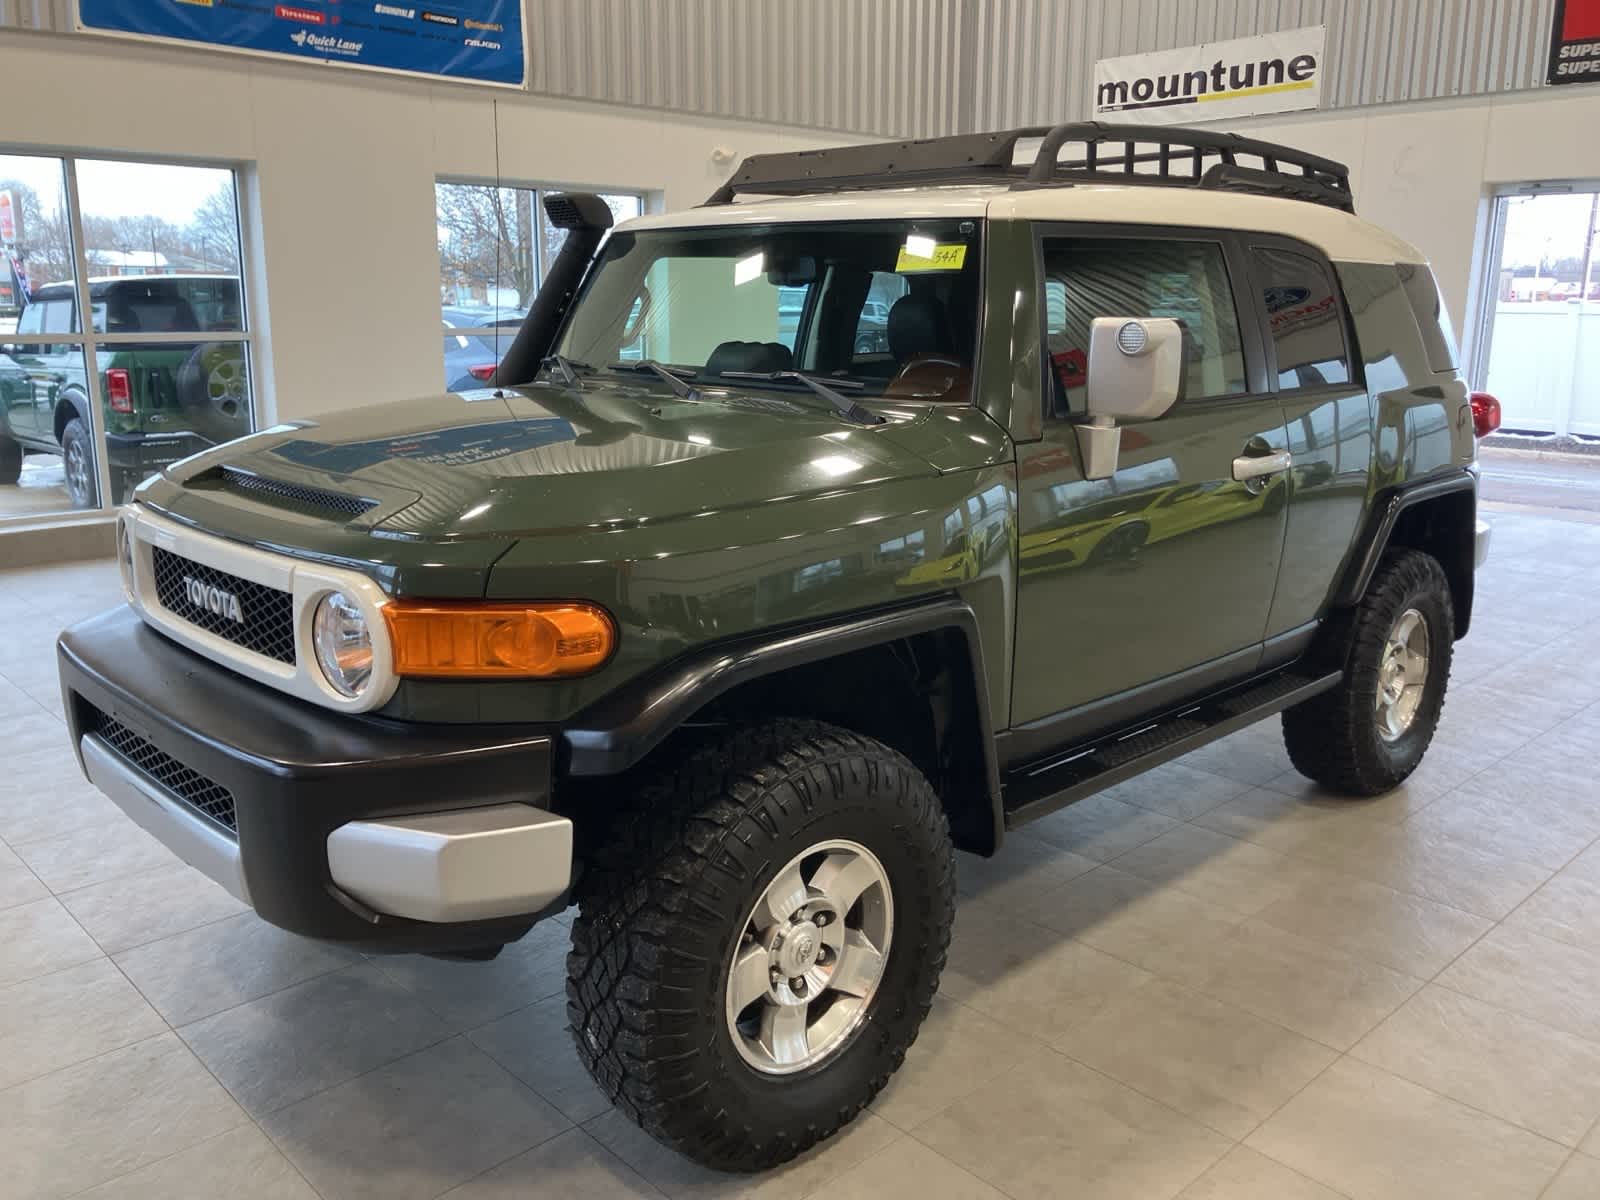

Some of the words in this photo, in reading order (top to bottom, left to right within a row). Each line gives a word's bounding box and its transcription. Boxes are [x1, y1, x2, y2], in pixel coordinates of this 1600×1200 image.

[307, 33, 337, 47] Quick
[336, 38, 363, 51] Lane
[1097, 54, 1317, 106] mountune
[183, 576, 244, 623] TOYOTA
